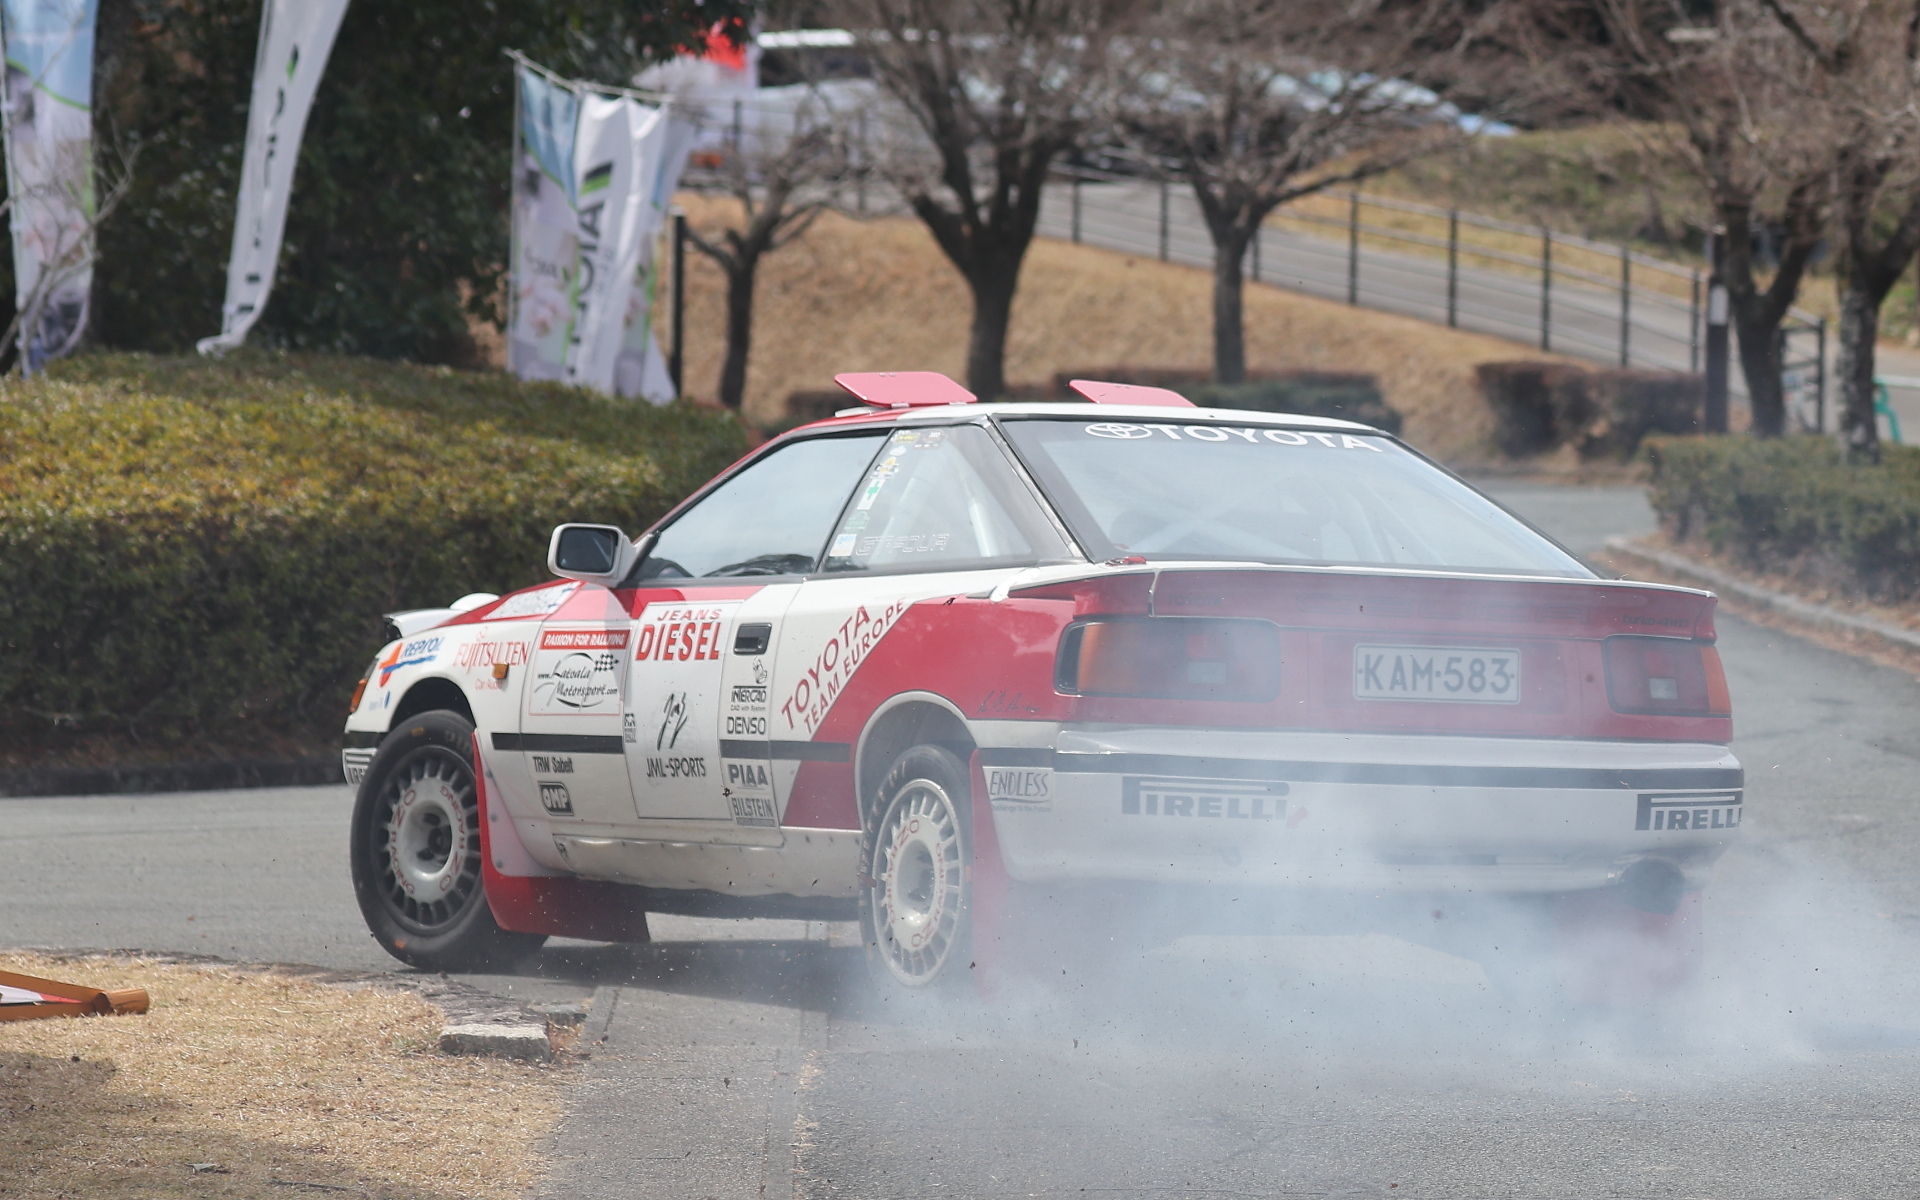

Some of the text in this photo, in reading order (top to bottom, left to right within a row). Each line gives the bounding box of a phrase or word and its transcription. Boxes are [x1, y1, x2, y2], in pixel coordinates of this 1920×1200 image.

[1143, 424, 1383, 453] TOYOTA
[657, 608, 722, 621] JEANS
[402, 636, 445, 658] REPSOL
[543, 633, 625, 646] PASSION FOR RALLYING
[635, 621, 721, 661] DIESEL
[781, 604, 870, 730] TOYOTA
[803, 597, 906, 734] TEAM EUROPE
[1363, 654, 1511, 694] KAM-583
[726, 716, 766, 735] DENSO
[532, 756, 574, 773] TRW Sabelt
[646, 757, 706, 777] JML-SPORTS
[727, 764, 768, 785] PIAA
[989, 771, 1048, 797] ENDLESS
[542, 787, 569, 809] OMP
[732, 797, 774, 818] BILSTEIN
[1121, 776, 1290, 820] PIRELLI
